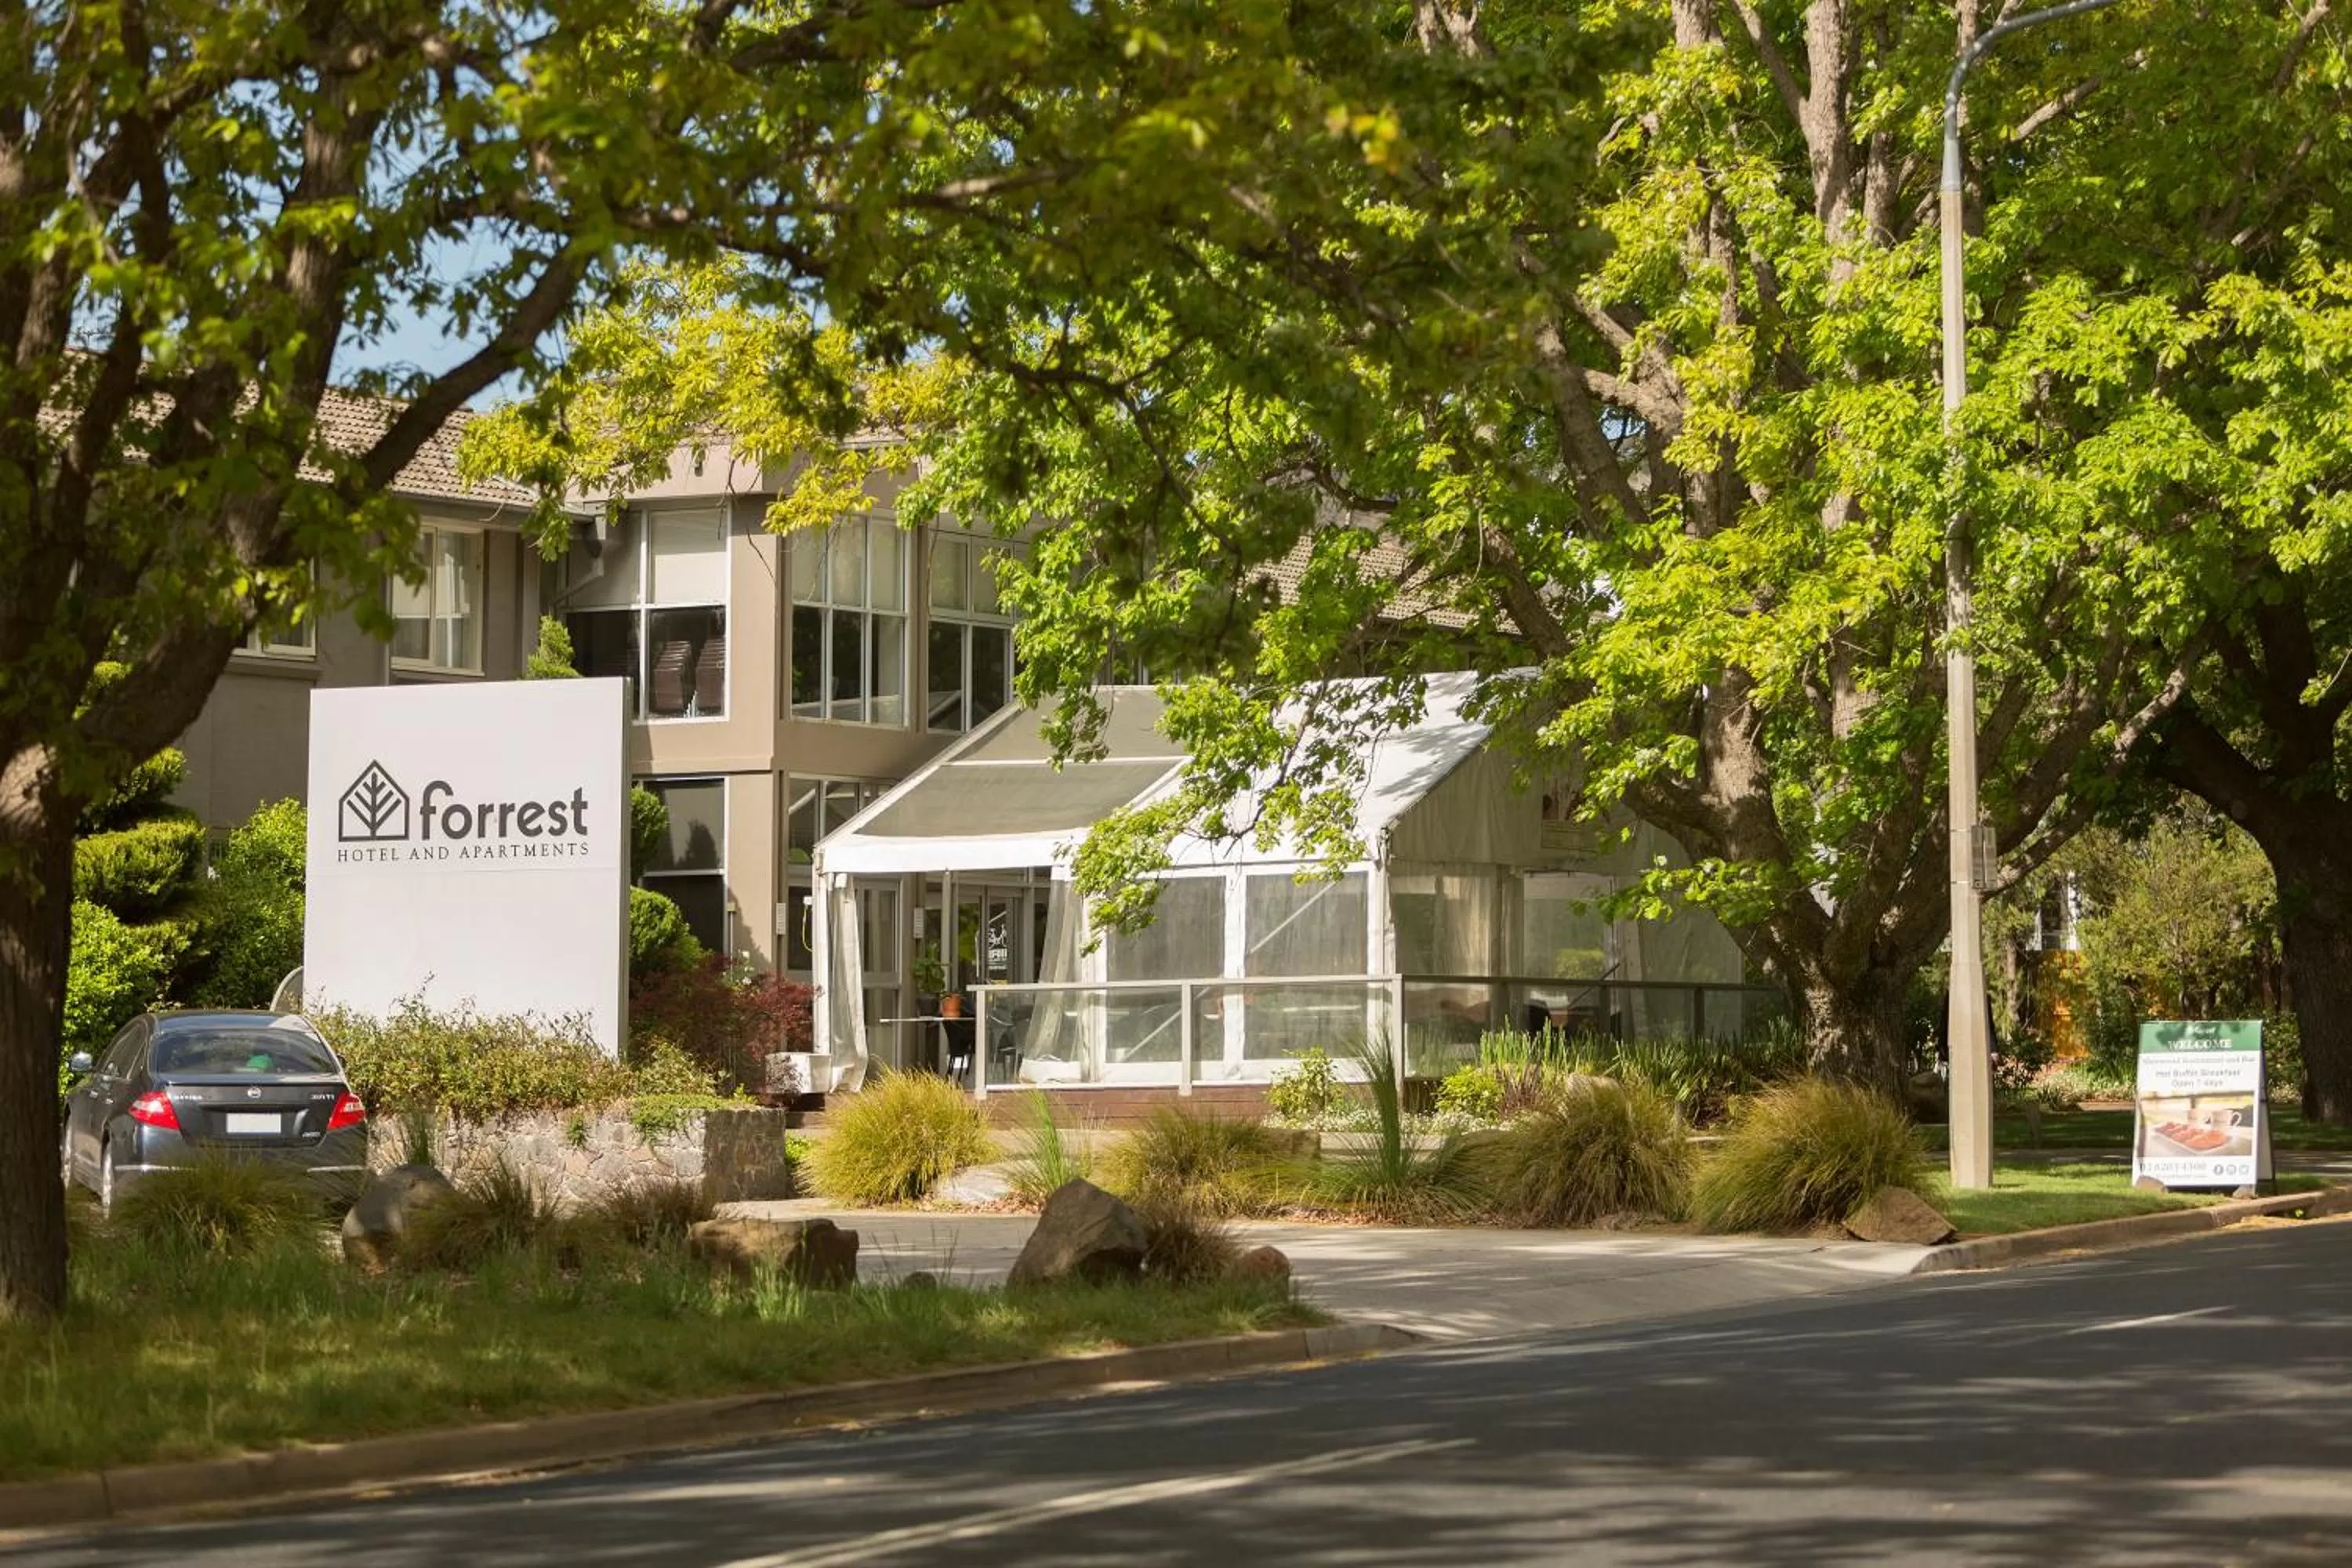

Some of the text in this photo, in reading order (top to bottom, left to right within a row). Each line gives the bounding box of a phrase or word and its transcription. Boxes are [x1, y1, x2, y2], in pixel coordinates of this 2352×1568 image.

[419, 780, 588, 840] forrest
[337, 842, 589, 862] HOTEL AND APARTMENTS
[2168, 1038, 2233, 1050] WELCOME
